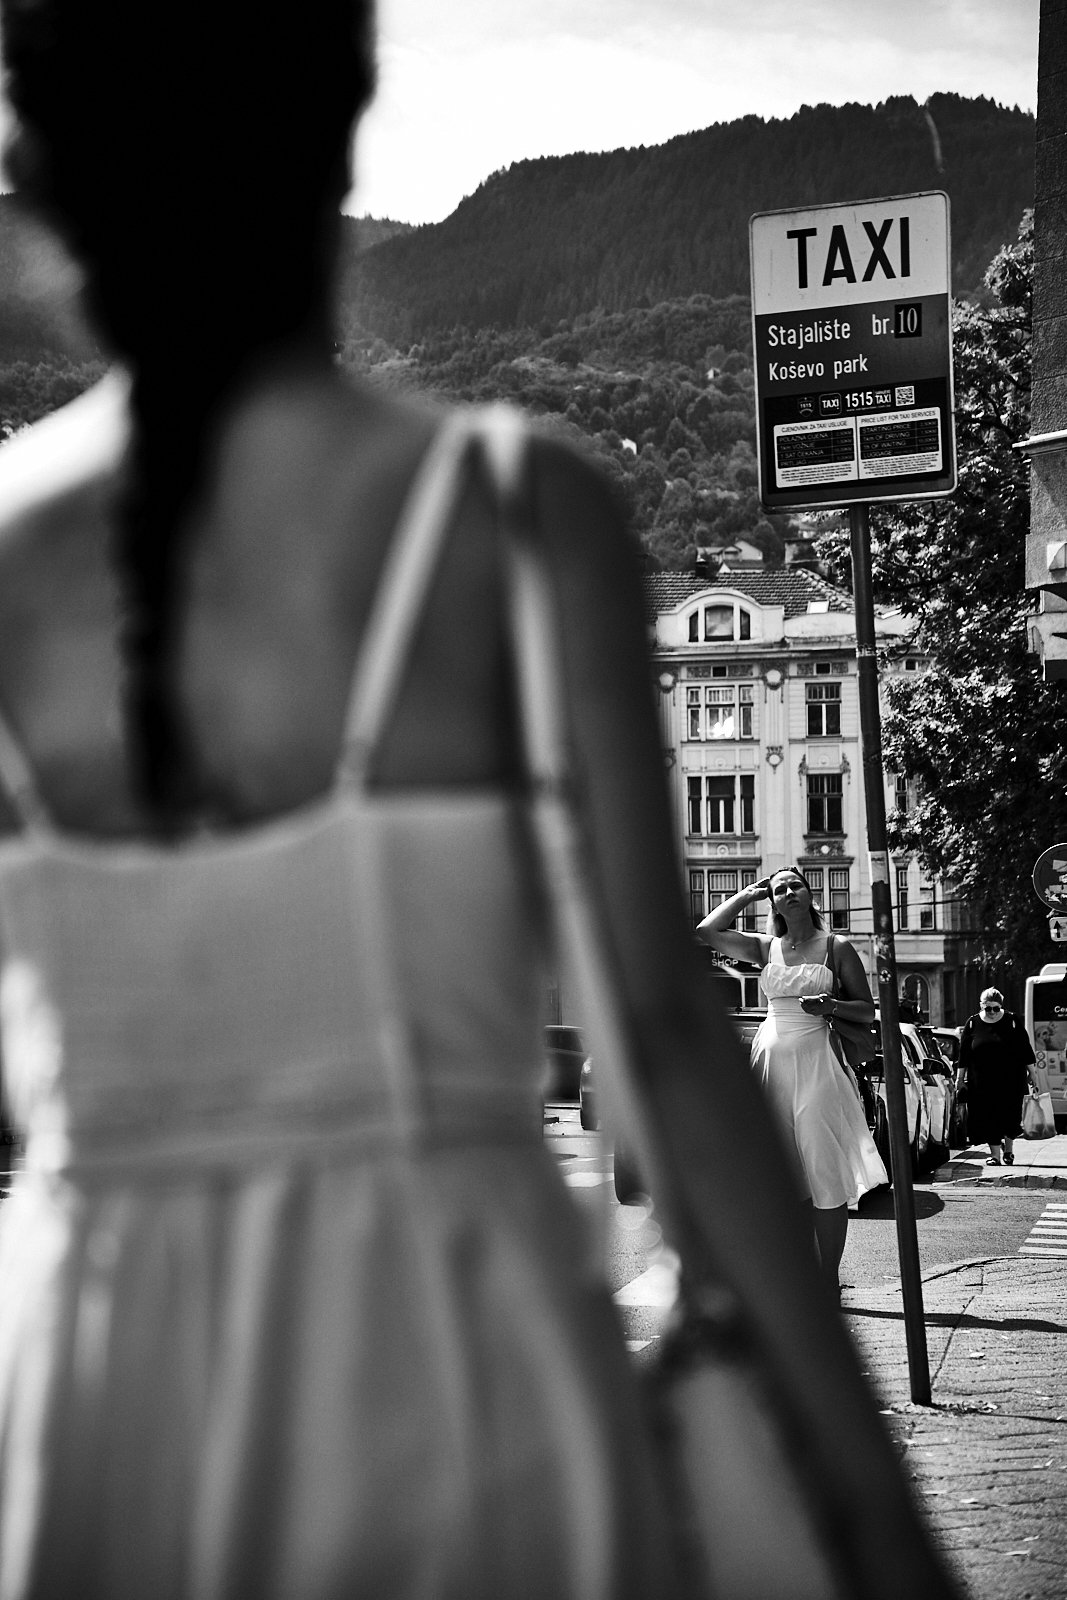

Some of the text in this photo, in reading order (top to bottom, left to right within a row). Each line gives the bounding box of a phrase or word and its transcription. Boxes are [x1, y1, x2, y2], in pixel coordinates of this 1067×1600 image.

[787, 217, 910, 289] TAXI
[768, 307, 918, 350] Stajalište br. 10
[769, 353, 869, 381] Koševo park
[844, 391, 873, 408] 1515
[875, 393, 892, 404] TAXI
[876, 415, 887, 423] LIST
[911, 410, 936, 418] SERVICES
[862, 425, 892, 433] STARTING
[884, 432, 910, 440] DRIVING
[881, 440, 906, 448] WAITING
[863, 450, 893, 458] LUGGAGE
[711, 958, 739, 967] SHOP
